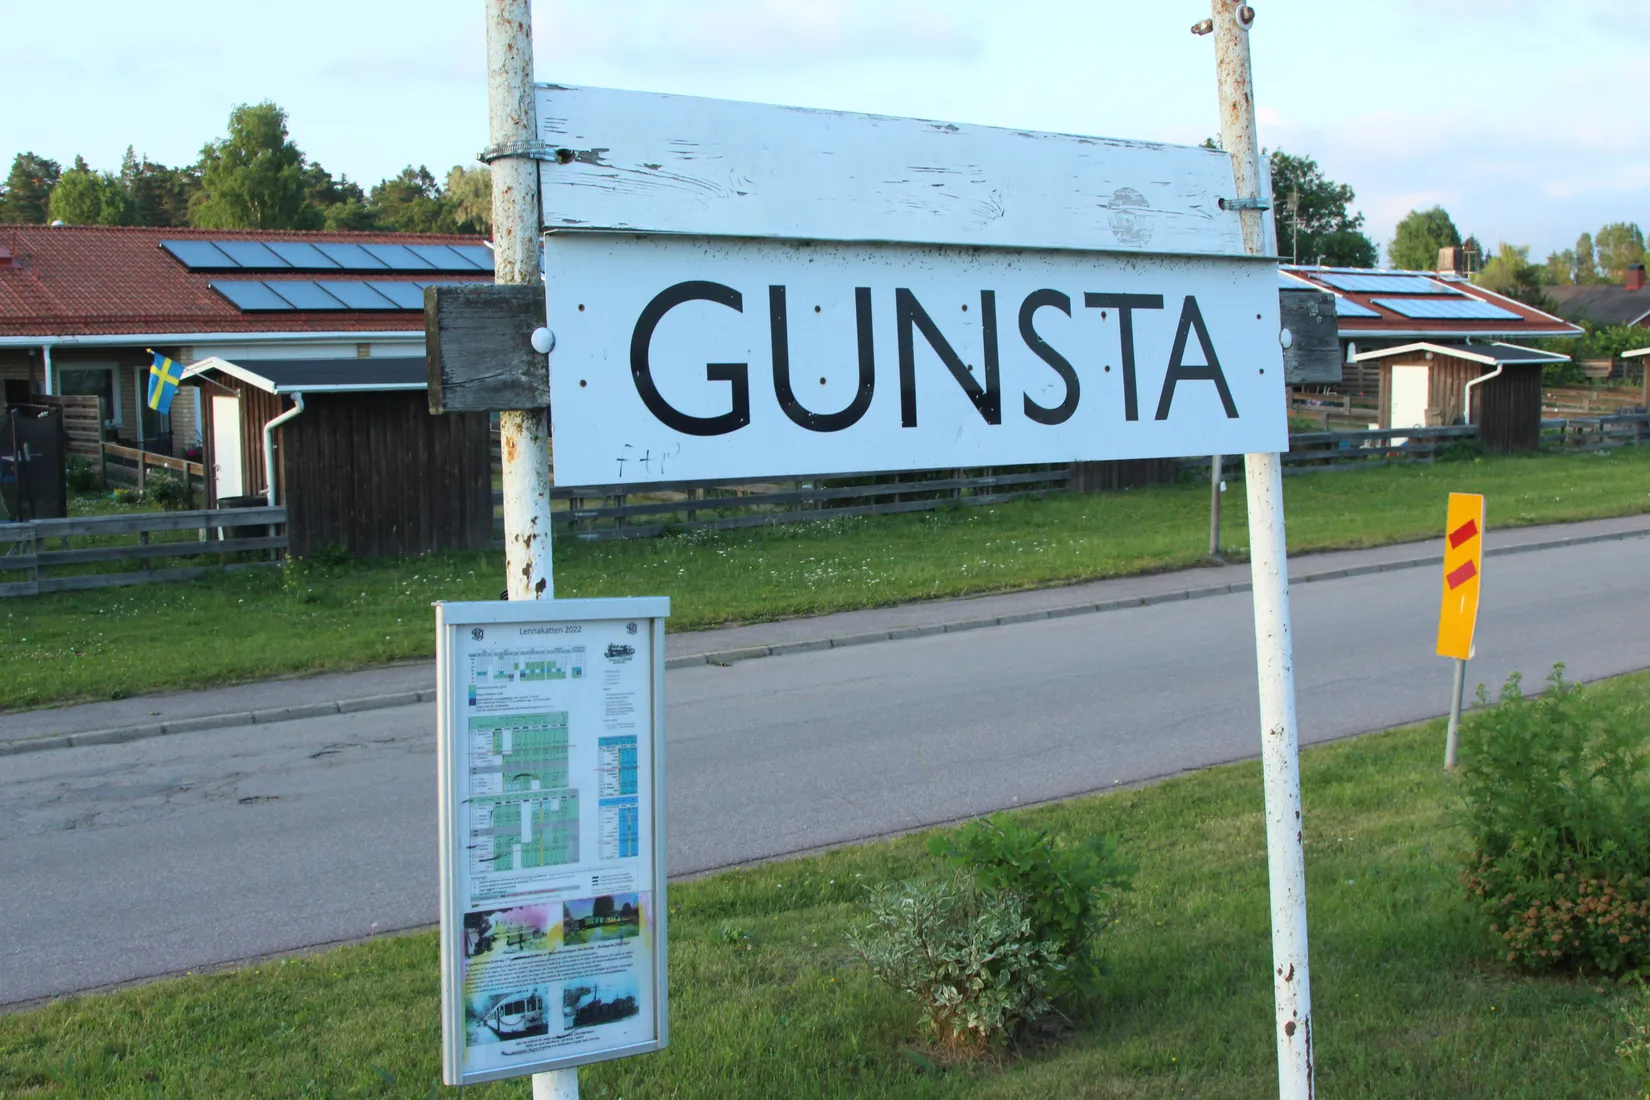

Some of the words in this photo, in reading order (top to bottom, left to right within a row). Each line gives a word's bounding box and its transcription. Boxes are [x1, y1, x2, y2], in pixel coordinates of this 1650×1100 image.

[630, 280, 1240, 437] GUNSTA
[519, 627, 564, 635] Lennakatten
[565, 625, 582, 634] 2022
